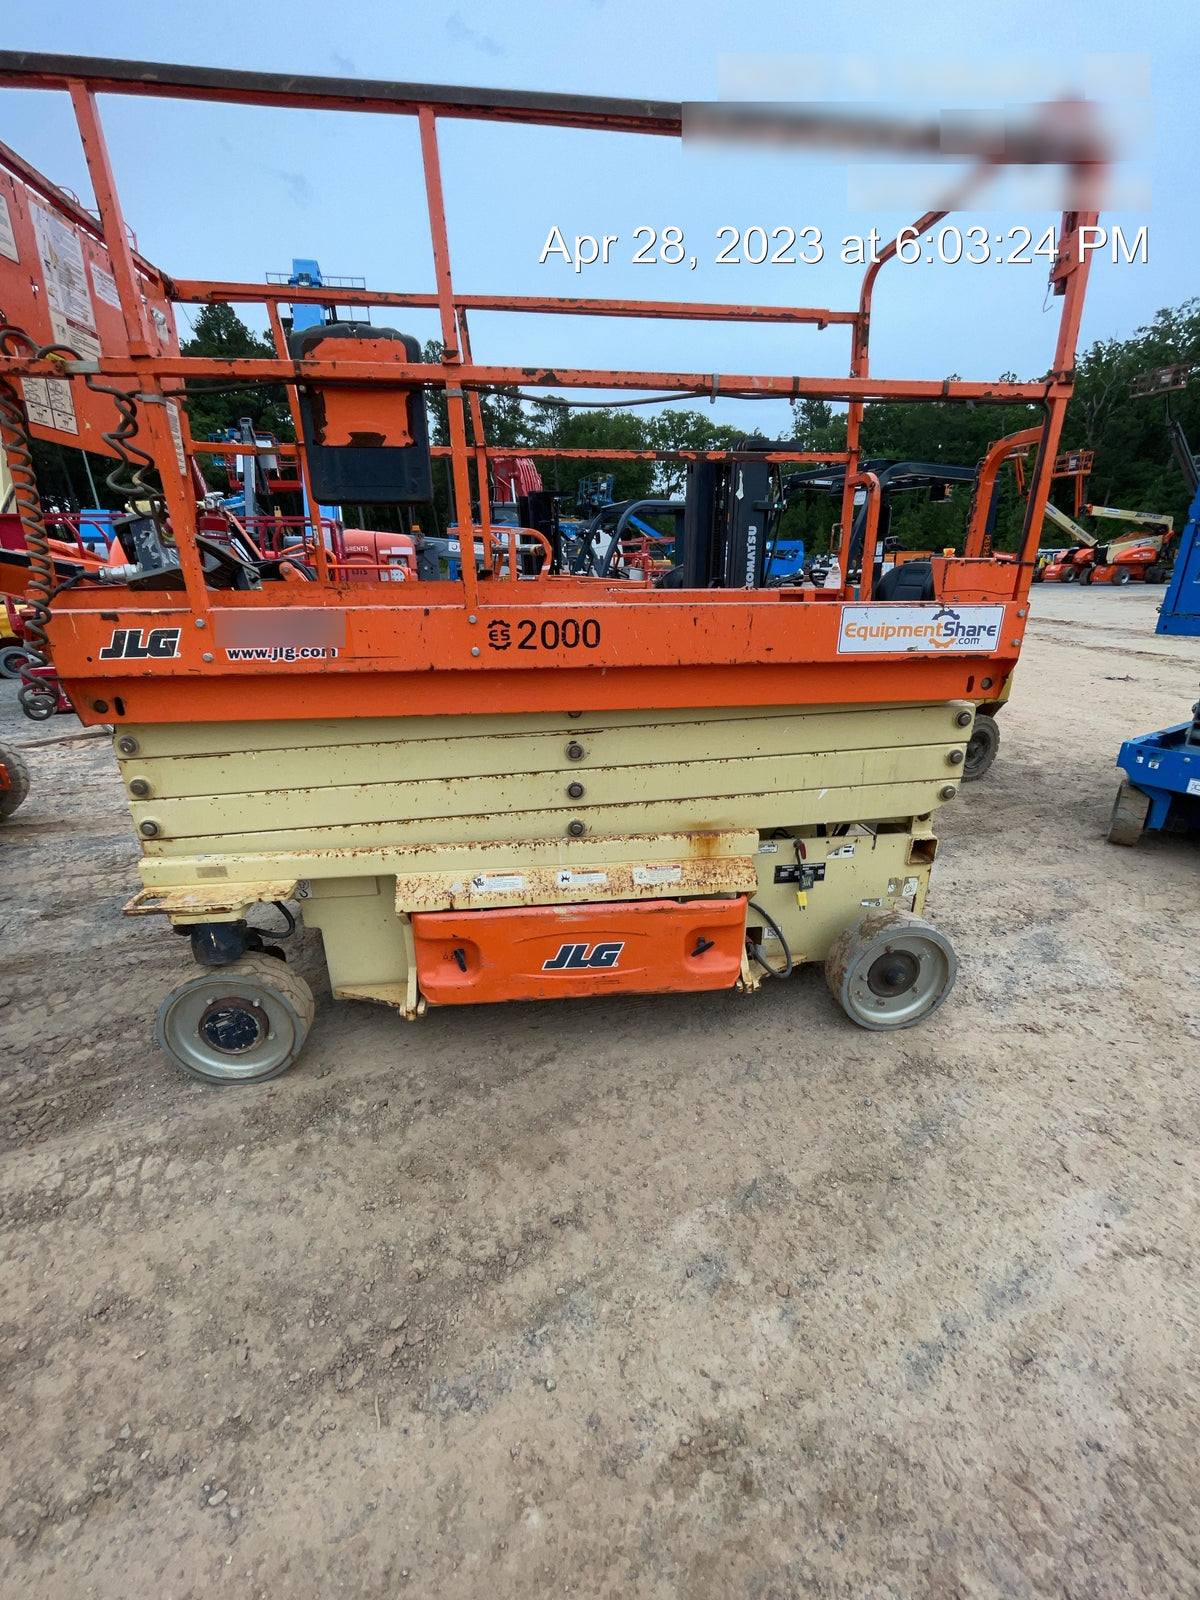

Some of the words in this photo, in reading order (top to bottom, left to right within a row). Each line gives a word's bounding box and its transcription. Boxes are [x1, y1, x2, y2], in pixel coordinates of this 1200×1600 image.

[99, 628, 181, 659] JLG
[517, 619, 601, 650] 2000
[845, 622, 997, 641] EquipmentShare
[541, 942, 626, 970] JLG
